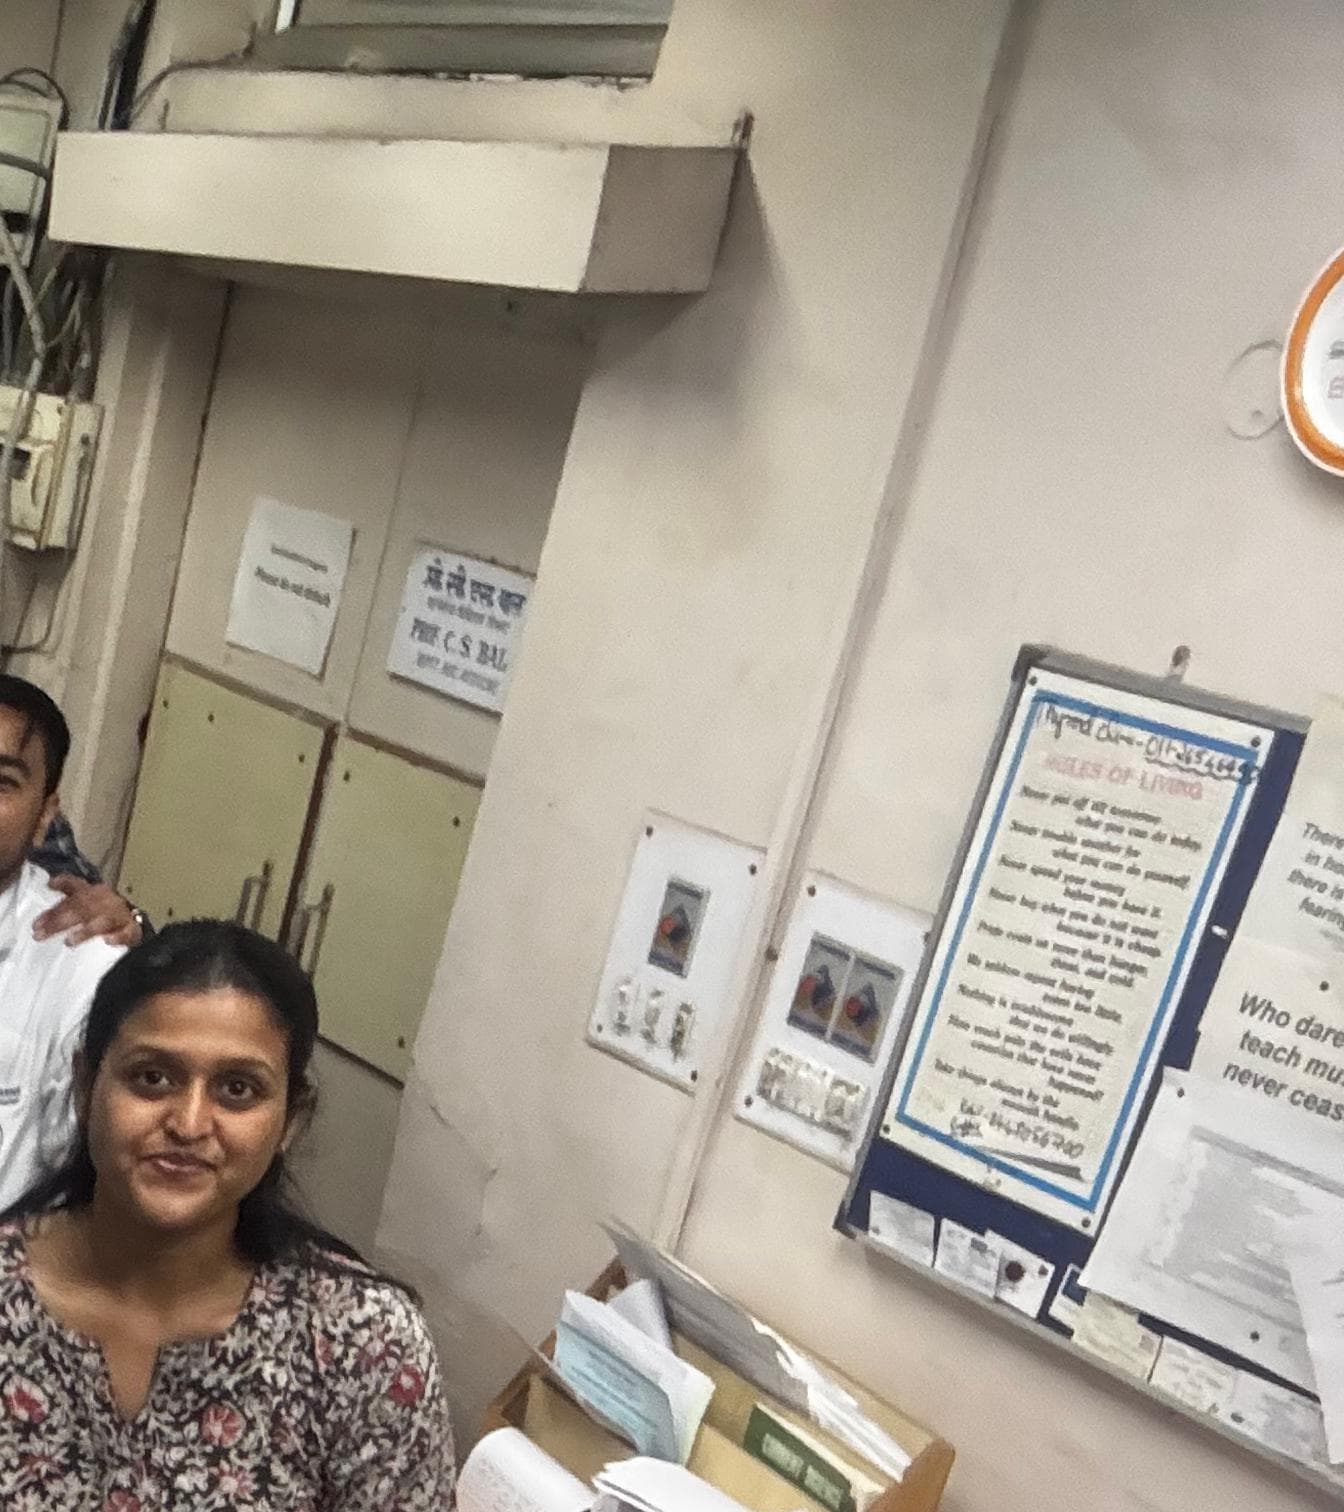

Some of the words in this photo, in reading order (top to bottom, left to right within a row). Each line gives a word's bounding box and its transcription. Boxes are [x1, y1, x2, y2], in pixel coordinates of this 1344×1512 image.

[1240, 991, 1290, 1028] Who
[1240, 1030, 1301, 1068] teach
[1304, 1058, 1344, 1087] mu
[1223, 1063, 1289, 1098] never
